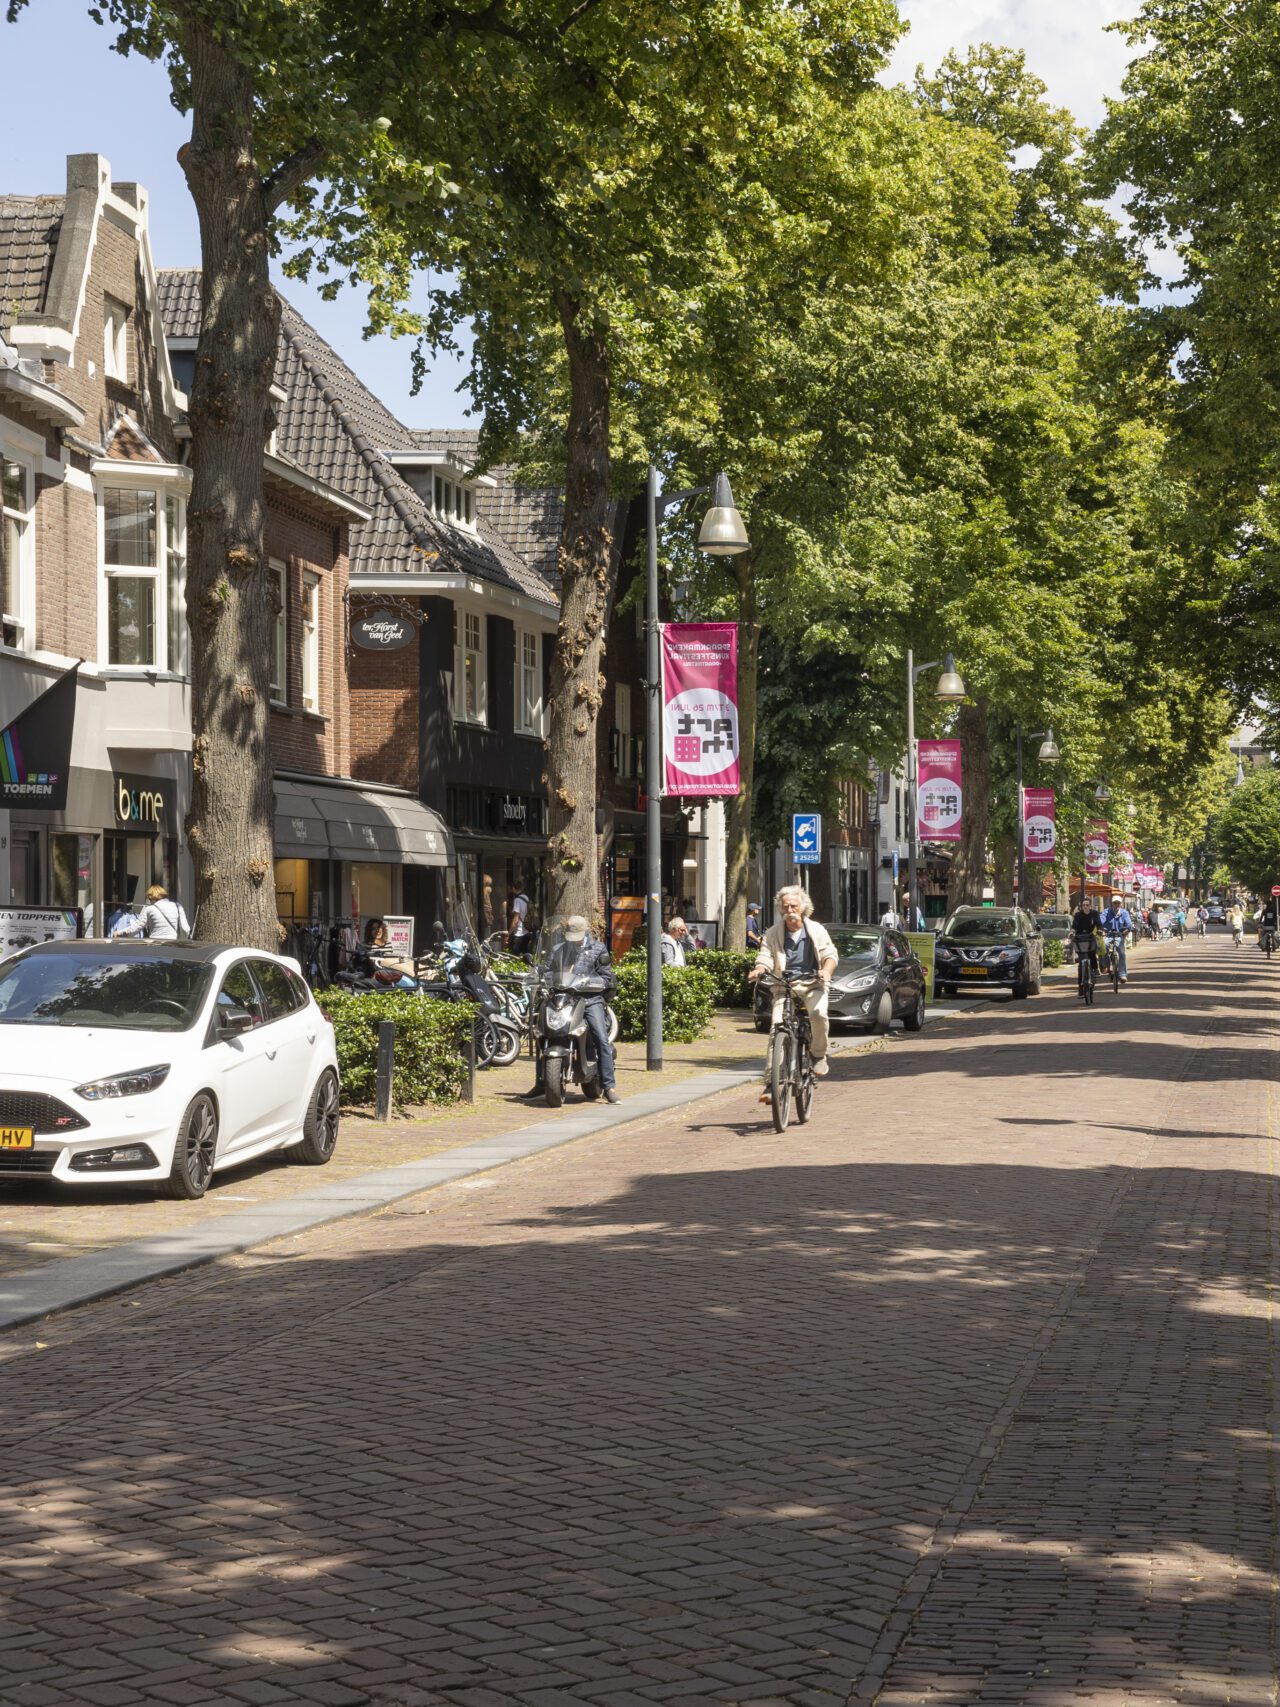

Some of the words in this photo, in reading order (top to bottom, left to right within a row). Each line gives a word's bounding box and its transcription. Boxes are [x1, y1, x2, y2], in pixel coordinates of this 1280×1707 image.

[3, 783, 53, 795] TOEMEN
[119, 778, 164, 823] b&me
[0, 912, 14, 920] EN
[16, 913, 62, 922] TOPPERS
[1, 1129, 25, 1146] HV
